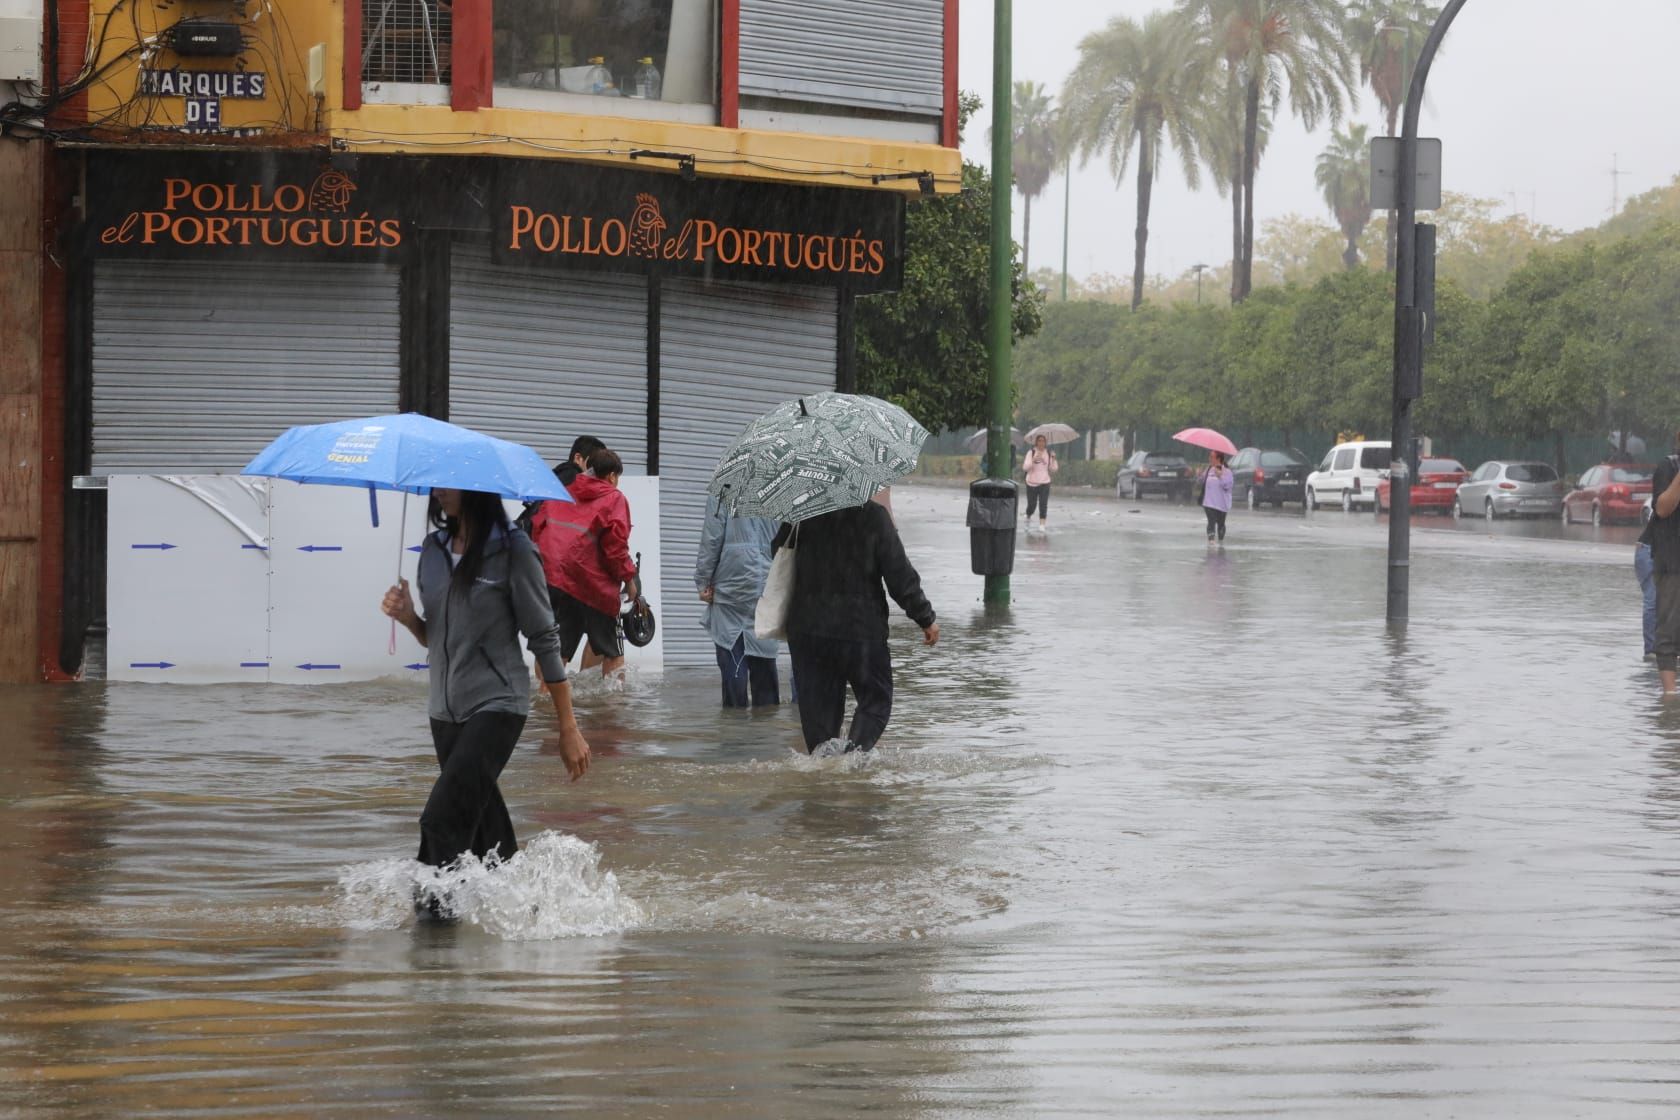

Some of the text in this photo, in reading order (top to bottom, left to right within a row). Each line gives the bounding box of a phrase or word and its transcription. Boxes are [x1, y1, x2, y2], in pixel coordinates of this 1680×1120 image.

[142, 72, 263, 96] MARQUES
[187, 101, 218, 122] DE
[165, 178, 305, 212] POLLO
[101, 211, 401, 247] el PORTUGUÉS
[510, 205, 884, 275] POLLO el PORTUGUÉS
[327, 453, 369, 463] GENIAL
